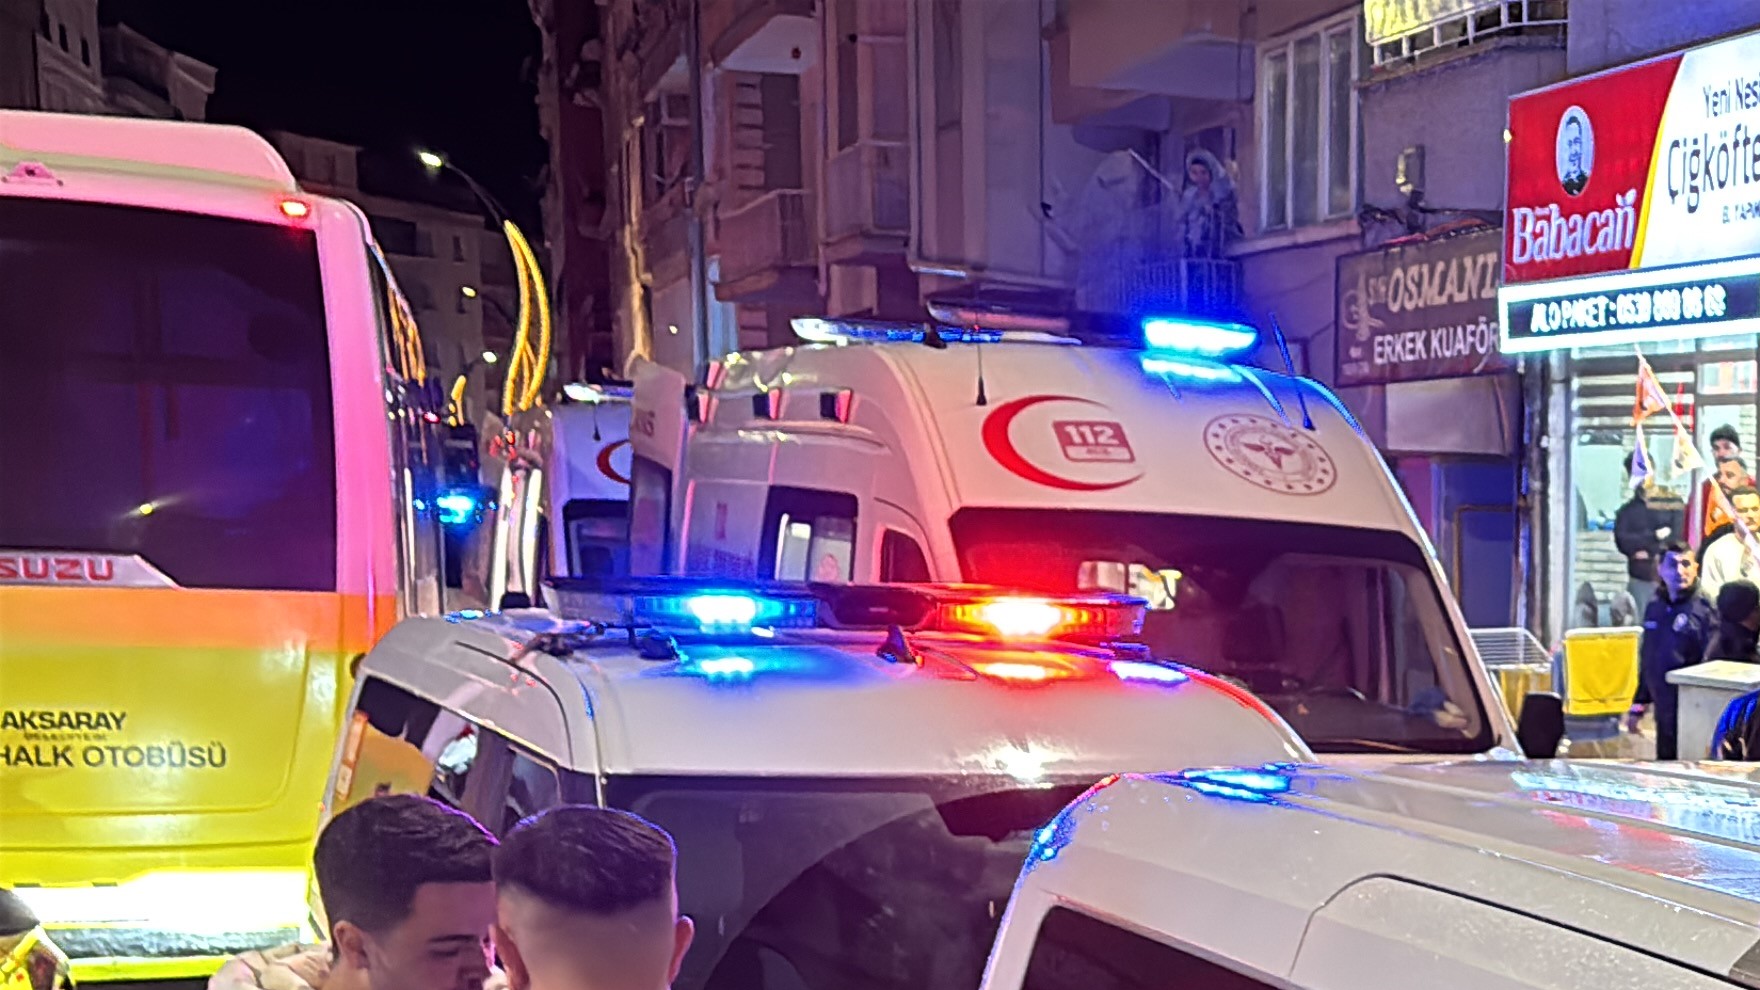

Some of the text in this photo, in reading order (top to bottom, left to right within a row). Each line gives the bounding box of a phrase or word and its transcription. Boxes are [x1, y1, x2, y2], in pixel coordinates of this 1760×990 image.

[1702, 80, 1731, 118] Yeni
[1373, 329, 1428, 365] ERKEK
[1063, 424, 1121, 445] 112
[0, 710, 127, 730] AKSARAY
[82, 739, 227, 768] OTOBÜSÜ
